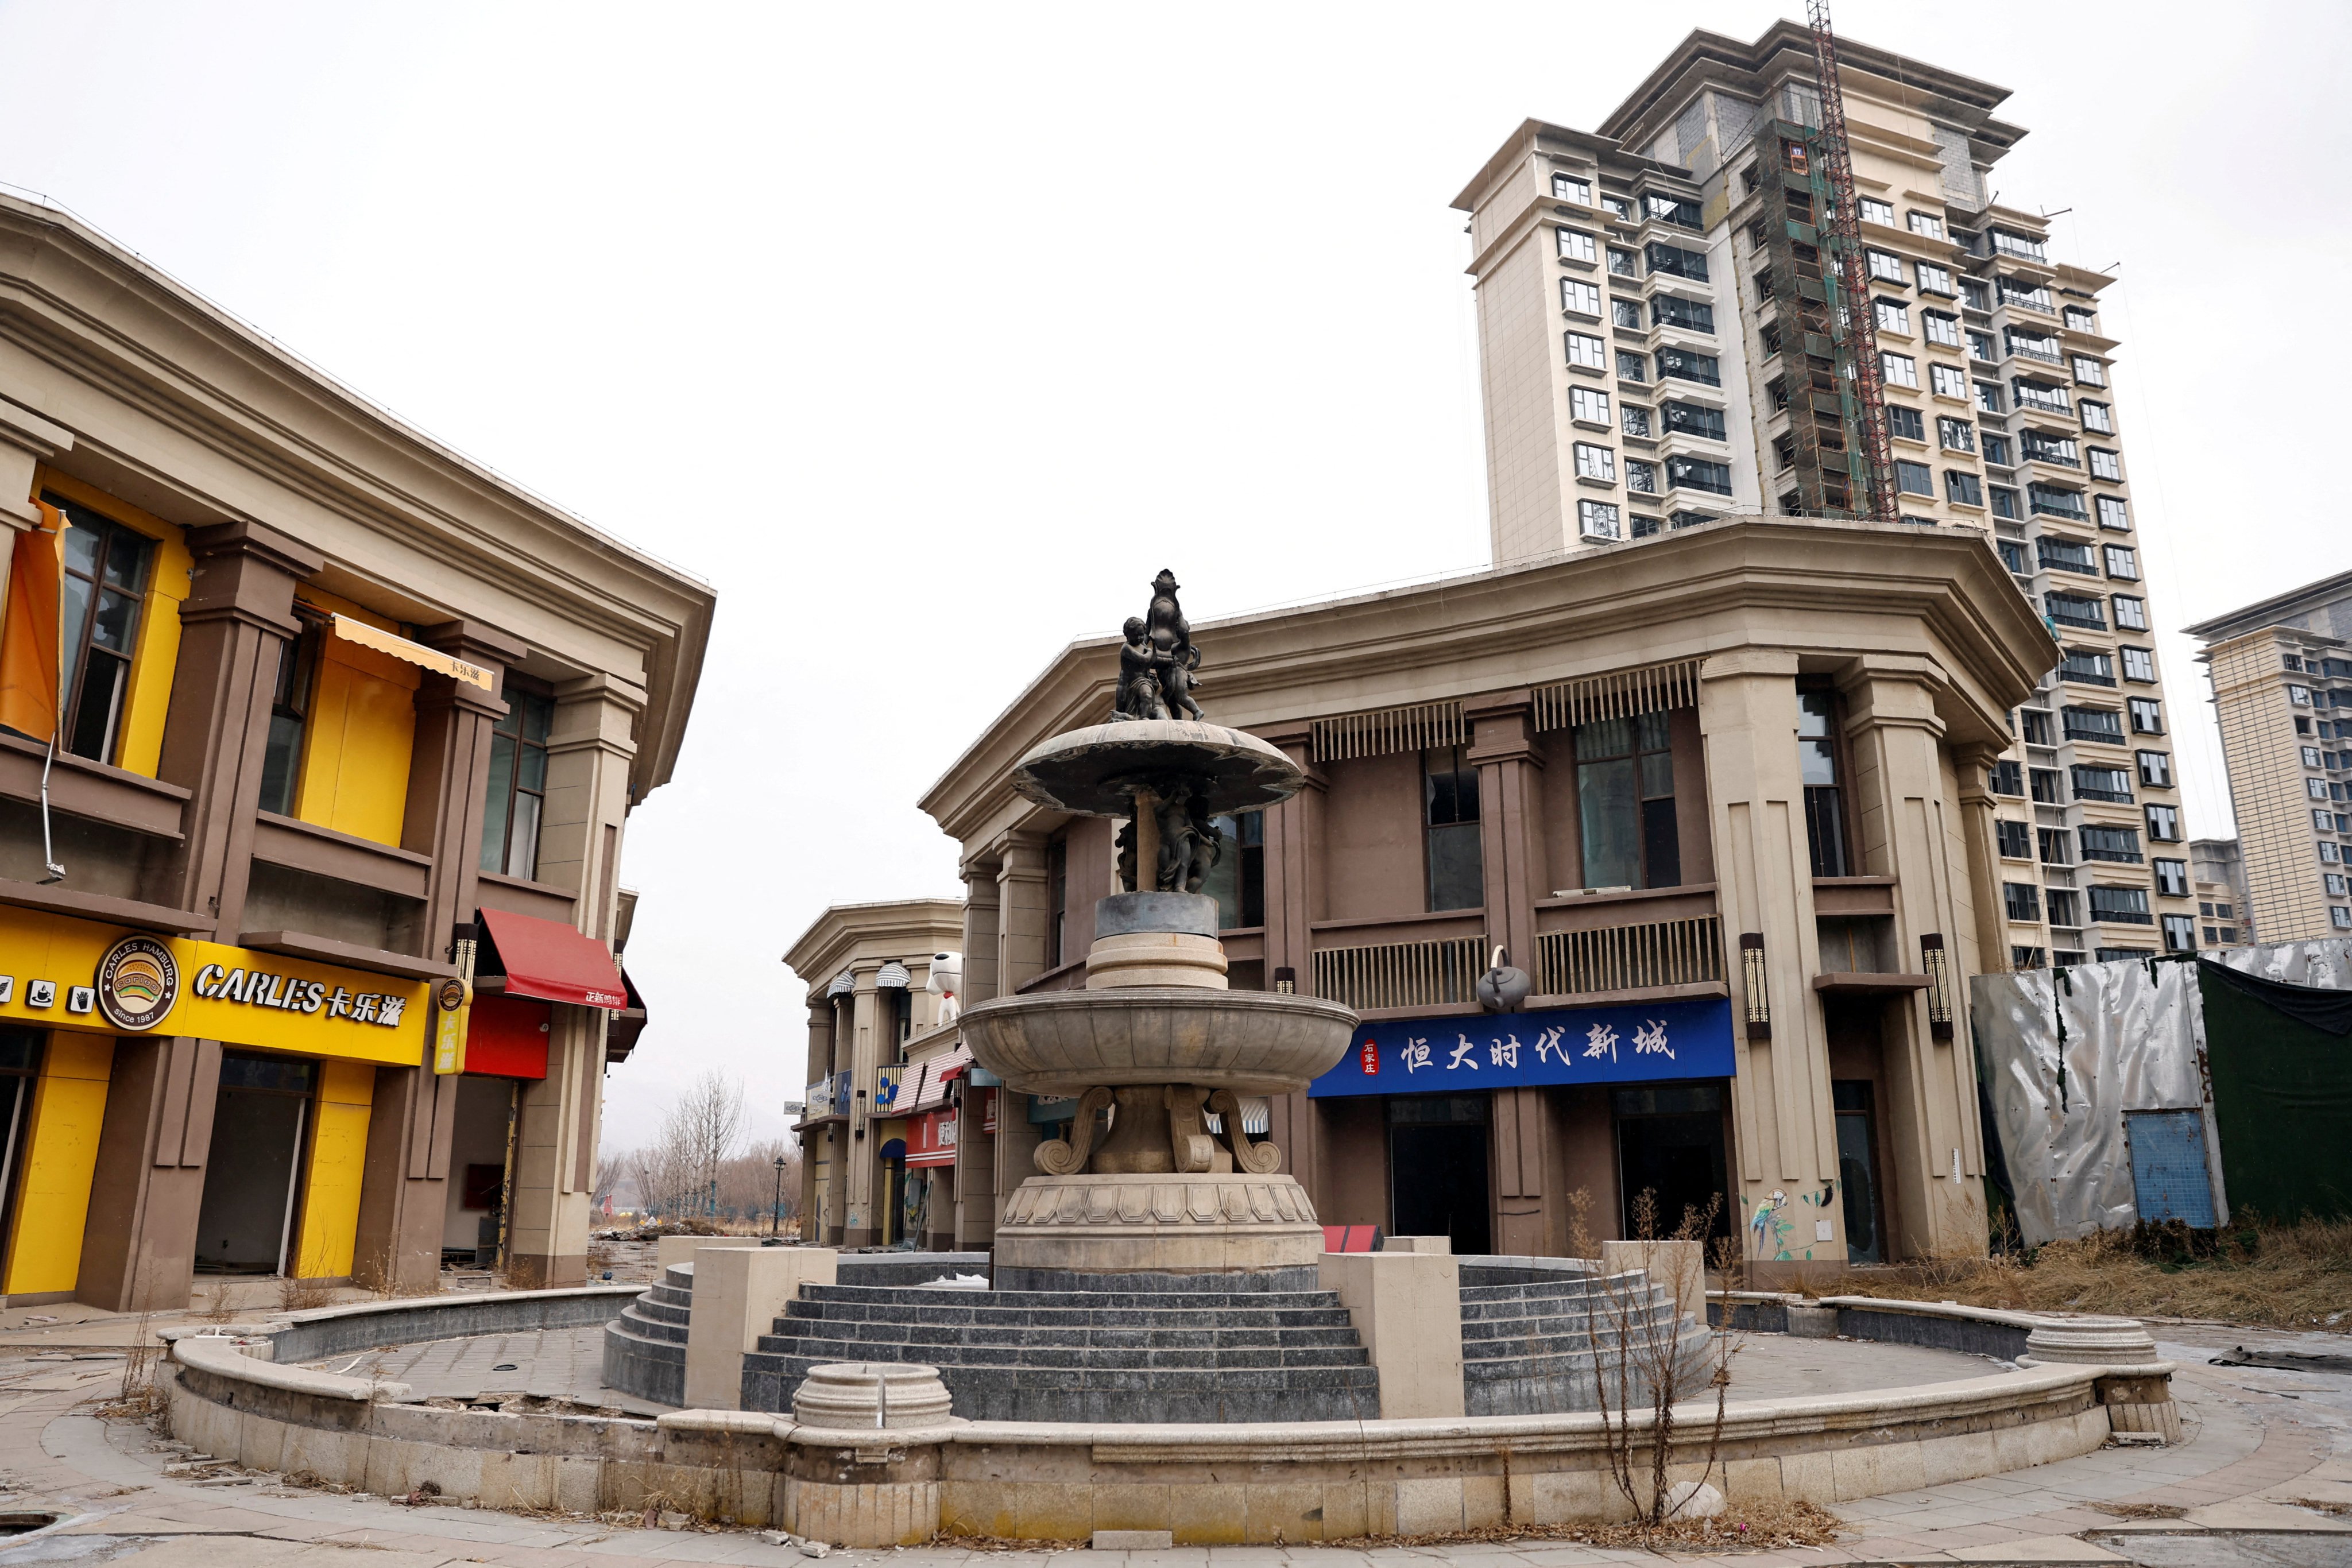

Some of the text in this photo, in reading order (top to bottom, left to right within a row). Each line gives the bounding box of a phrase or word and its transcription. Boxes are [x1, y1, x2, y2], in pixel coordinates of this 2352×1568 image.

[105, 943, 174, 987] CARLES HAMBURG
[117, 976, 158, 991] carles
[194, 963, 407, 1027] CARLES 卡乐滋
[114, 1008, 154, 1023] since 1987
[1364, 1044, 1376, 1073] 石家庄
[1401, 1019, 1675, 1074] 恒大时代新城
